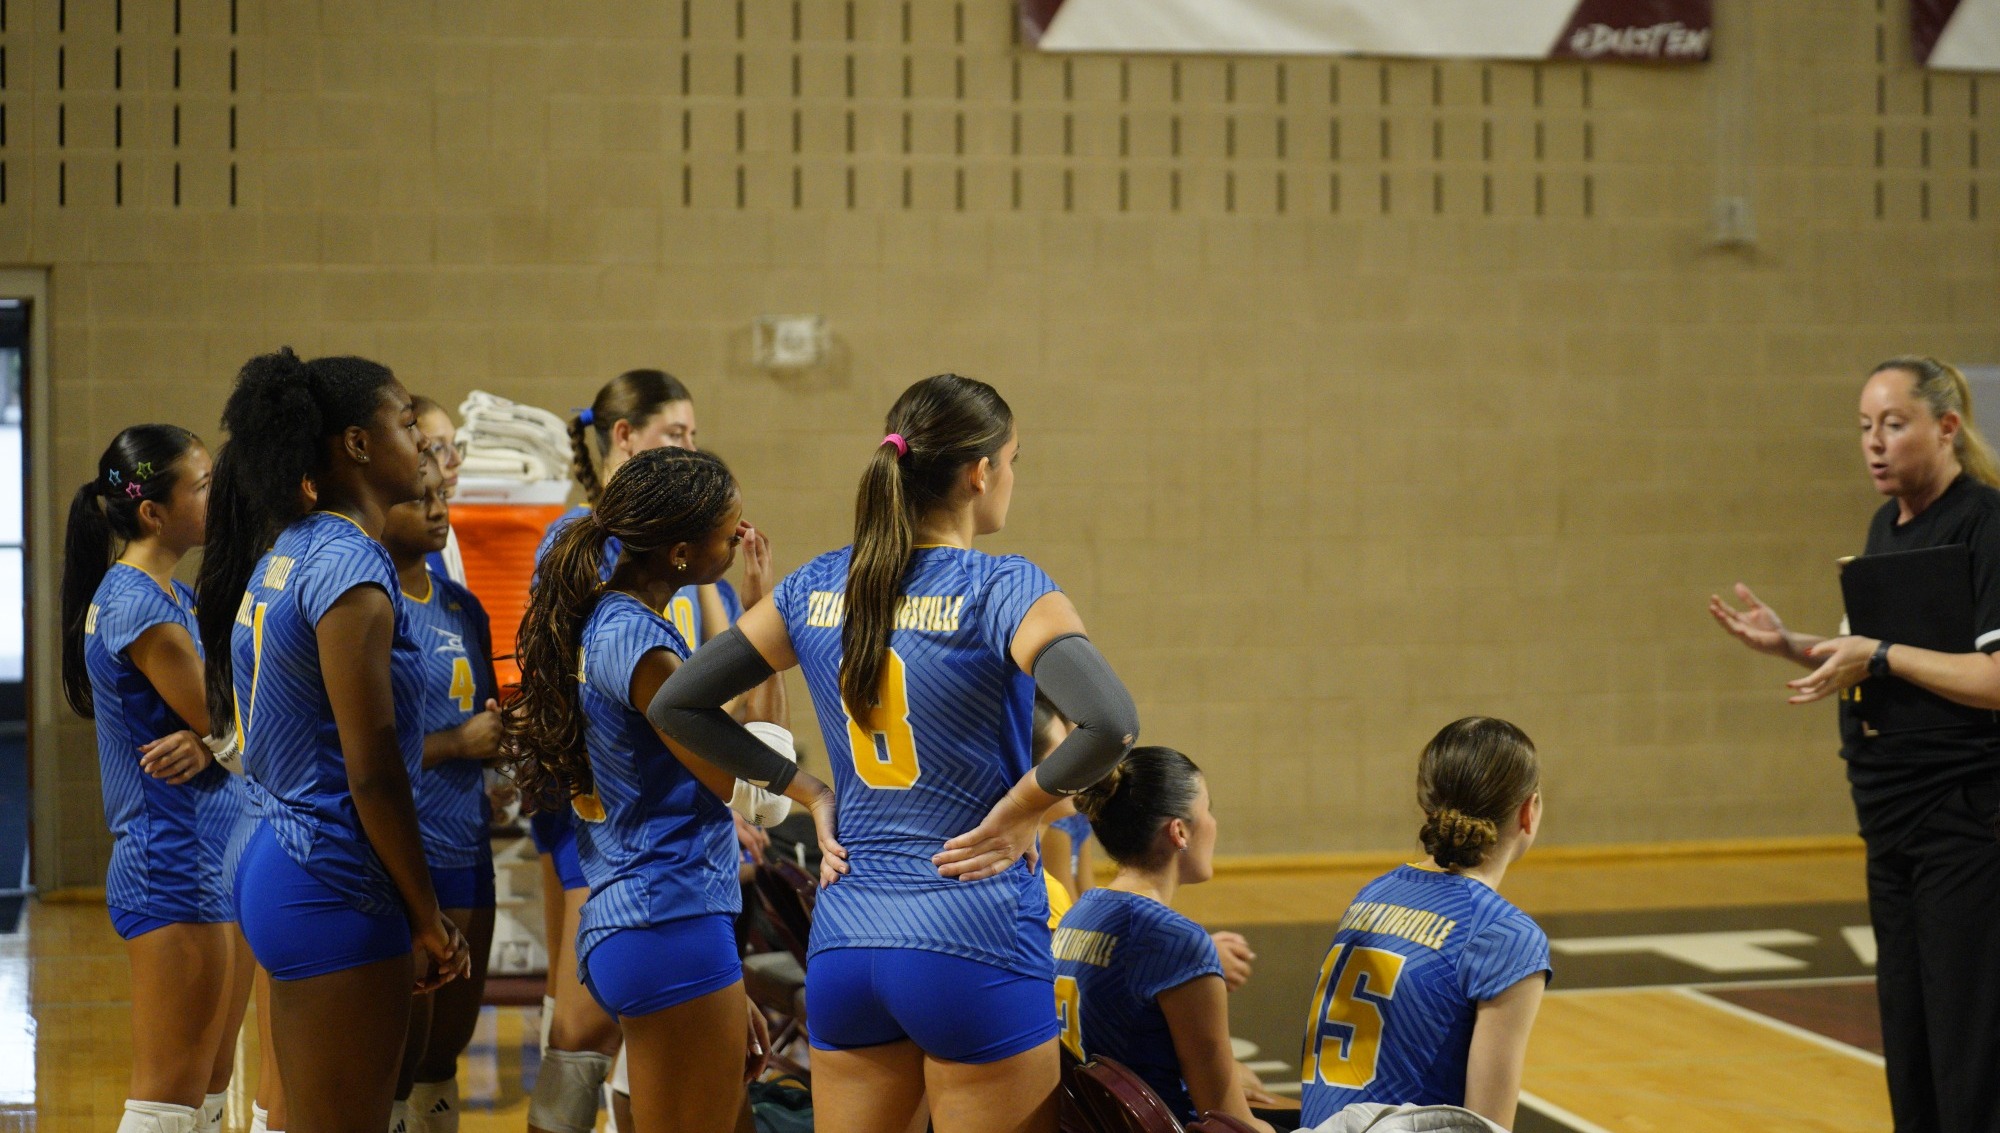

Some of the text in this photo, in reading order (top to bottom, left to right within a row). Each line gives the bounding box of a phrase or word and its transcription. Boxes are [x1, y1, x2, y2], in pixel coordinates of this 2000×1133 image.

[449, 657, 476, 712] 4
[839, 647, 922, 790] 8
[1302, 943, 1407, 1090] 15
